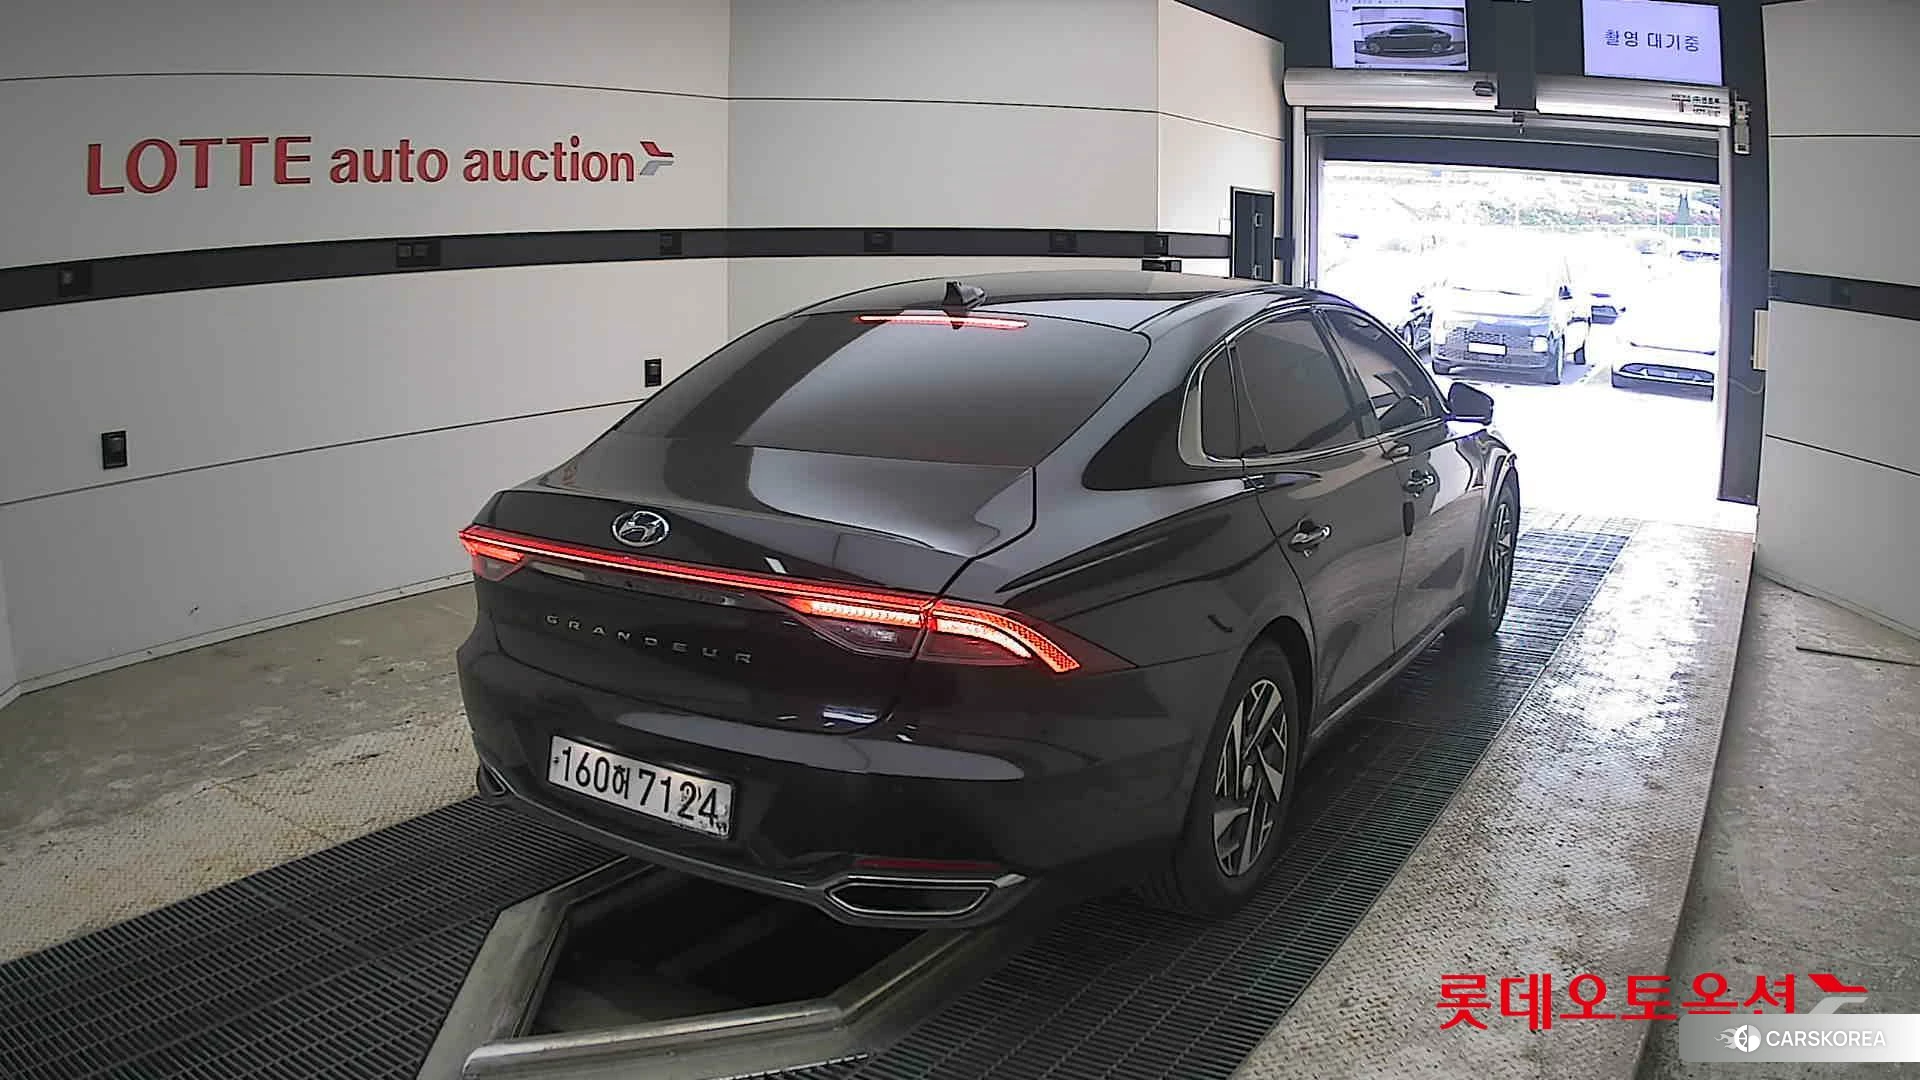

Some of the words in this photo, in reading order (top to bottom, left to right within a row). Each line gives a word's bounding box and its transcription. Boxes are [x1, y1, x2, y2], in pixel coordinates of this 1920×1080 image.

[1646, 32, 1699, 52] 대기중
[87, 136, 312, 195] LOTTE
[329, 138, 449, 184] auto
[463, 135, 635, 183] auction
[545, 614, 752, 664] GRANDEUR
